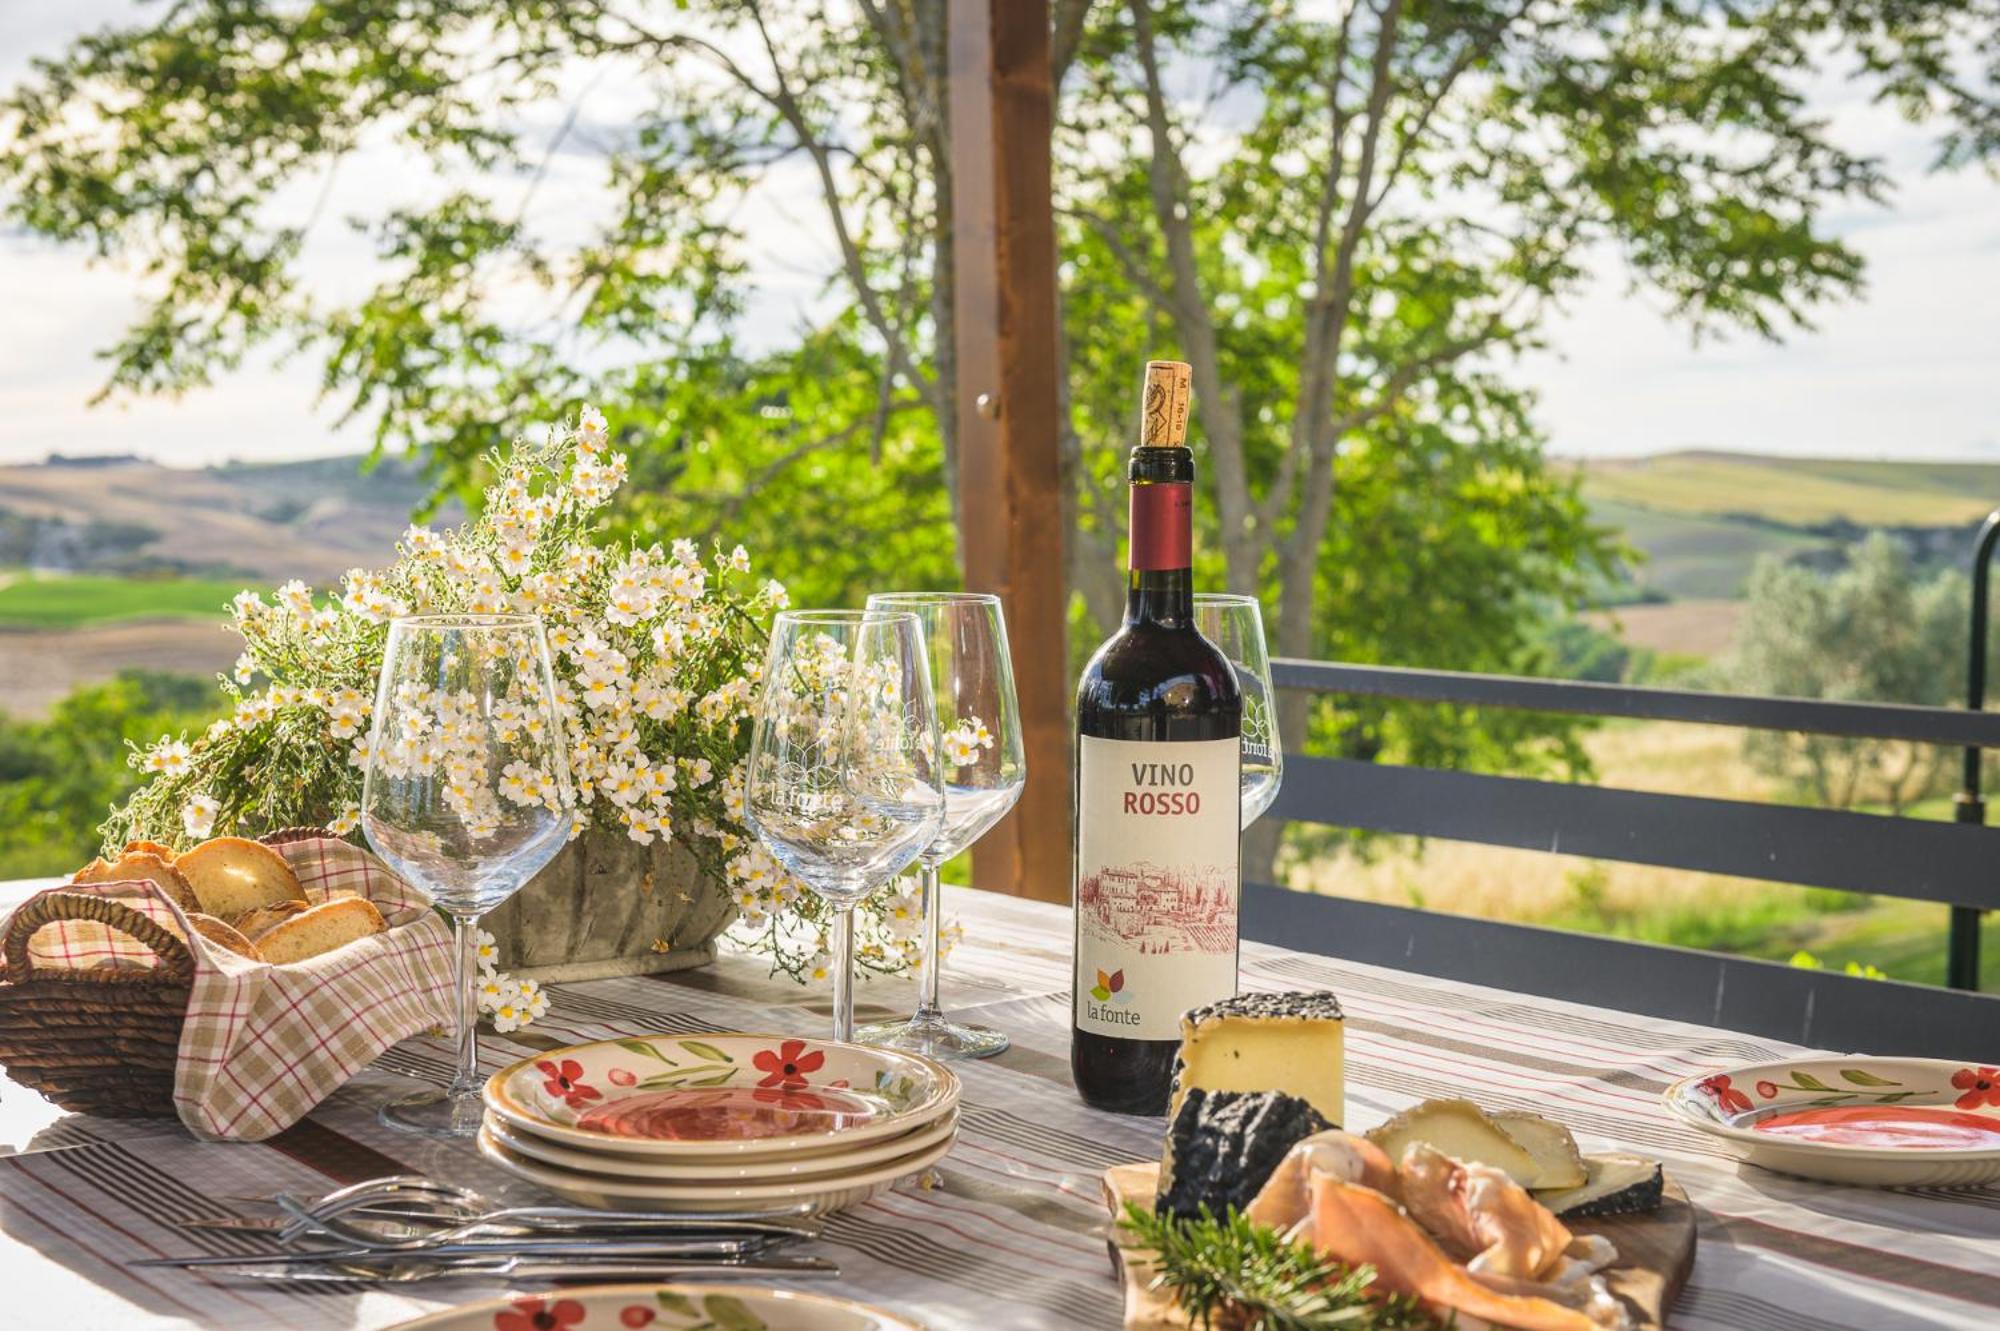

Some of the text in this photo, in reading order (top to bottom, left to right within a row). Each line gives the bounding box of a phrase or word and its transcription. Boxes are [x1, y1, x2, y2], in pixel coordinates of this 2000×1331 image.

[1131, 763, 1194, 787] VINO
[1123, 791, 1201, 815] ROSSO
[1087, 1000, 1141, 1026] la fonte
